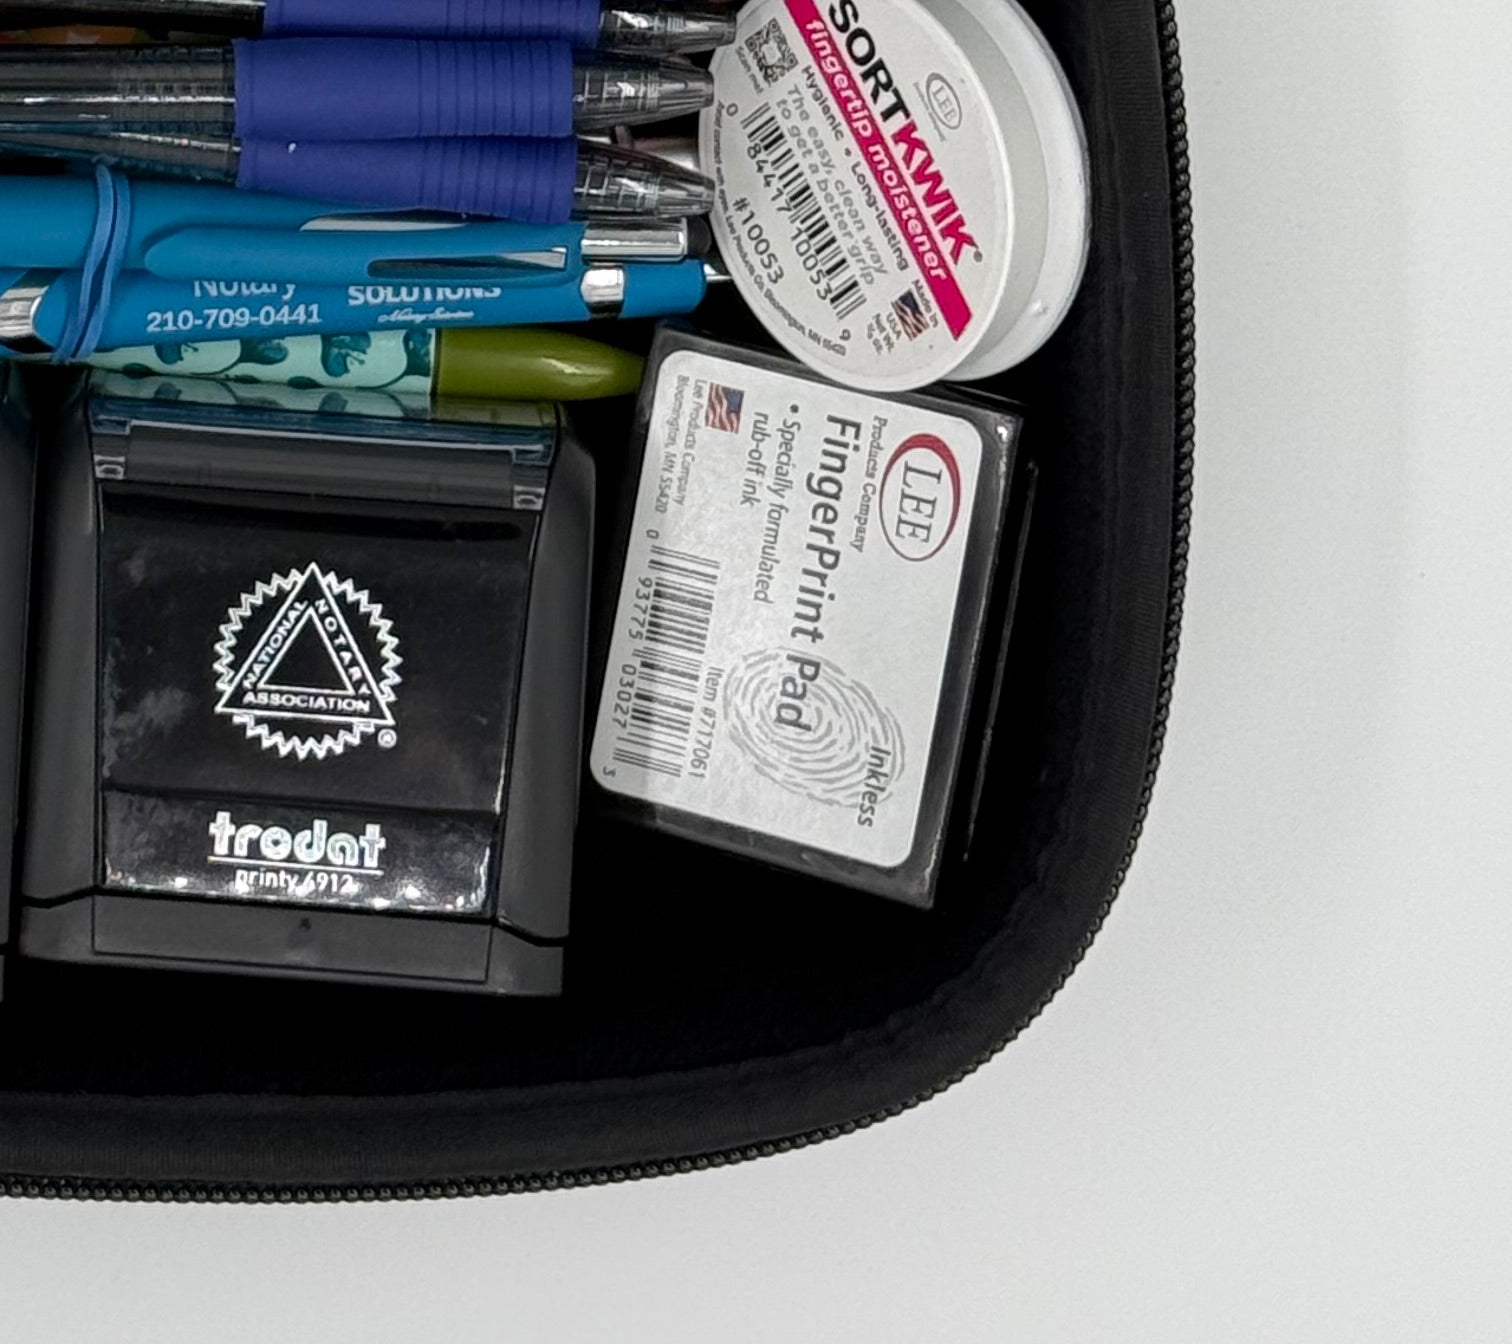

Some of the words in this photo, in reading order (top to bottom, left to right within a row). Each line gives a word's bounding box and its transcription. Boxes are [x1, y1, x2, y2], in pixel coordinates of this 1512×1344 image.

[776, 99, 791, 120] to
[929, 84, 960, 123] LEE
[781, 125, 813, 166] get
[802, 65, 843, 140] Hygienic
[851, 162, 909, 271] Long-lasting
[806, 19, 873, 138] fingertip
[867, 143, 949, 280] moistener
[808, 164, 819, 182] a
[726, 103, 738, 116] 0
[747, 142, 792, 213] 84417
[790, 226, 833, 301] 10053
[788, 84, 810, 121] The
[799, 127, 836, 180] easy,
[835, 180, 865, 231] clean
[856, 236, 888, 274] way
[818, 180, 854, 238] better
[733, 197, 785, 284] #10053
[847, 242, 876, 285] grip
[146, 303, 322, 333] 210-709-0441
[887, 312, 901, 340] USA
[690, 378, 709, 402] Lee
[680, 400, 706, 451] Products
[746, 412, 771, 476] rub-off
[865, 416, 888, 479] Products
[659, 449, 678, 474] MN
[672, 453, 695, 506] Company
[767, 419, 801, 498] Specially
[740, 479, 762, 506] ink
[850, 483, 876, 552] Company
[894, 461, 942, 542] LEE
[643, 527, 660, 540] 0
[754, 503, 789, 603] formulated
[791, 415, 861, 643] FingerPrint
[624, 574, 655, 642] 93775
[243, 598, 309, 688] NATIONAL
[314, 598, 372, 696] NOTARY
[242, 690, 371, 714] ASSOCIATION
[608, 661, 640, 730] 03027
[703, 667, 724, 702] Item
[770, 652, 823, 732] Pad
[688, 707, 716, 778] #717061
[851, 744, 893, 830] Inkless
[209, 811, 386, 868] trodat
